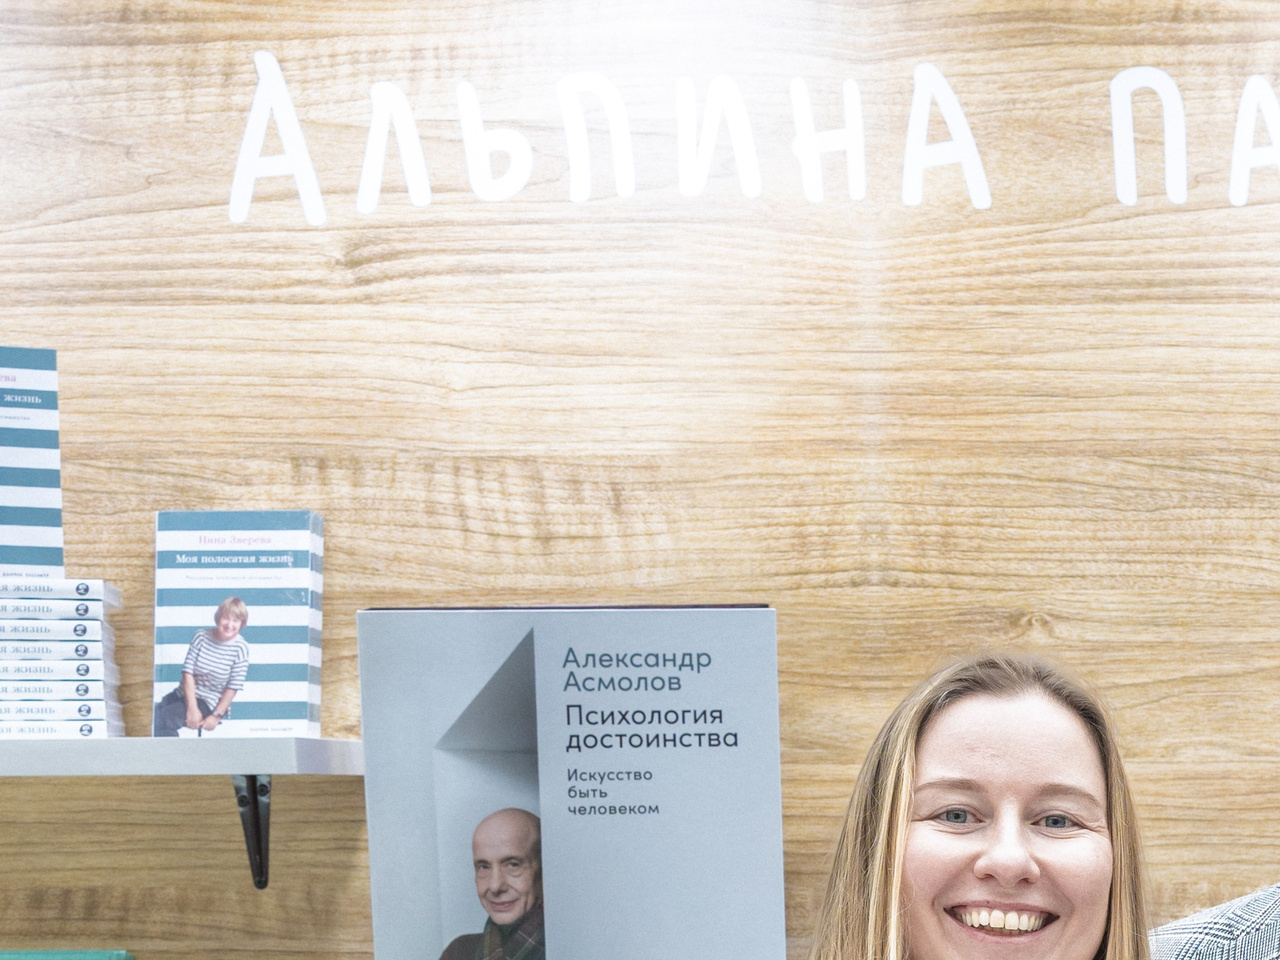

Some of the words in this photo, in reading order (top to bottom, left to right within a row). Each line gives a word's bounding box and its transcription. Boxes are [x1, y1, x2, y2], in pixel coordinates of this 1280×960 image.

[175, 554, 198, 564] Моя
[201, 554, 256, 564] полосатая
[258, 555, 294, 564] жизнь
[562, 647, 712, 674] Александр
[563, 671, 682, 692] Асмолов
[566, 704, 723, 726] Психология
[566, 731, 739, 753] достоинства
[567, 768, 653, 784] Искусство
[567, 785, 608, 799] быть
[568, 804, 660, 816] человеком
